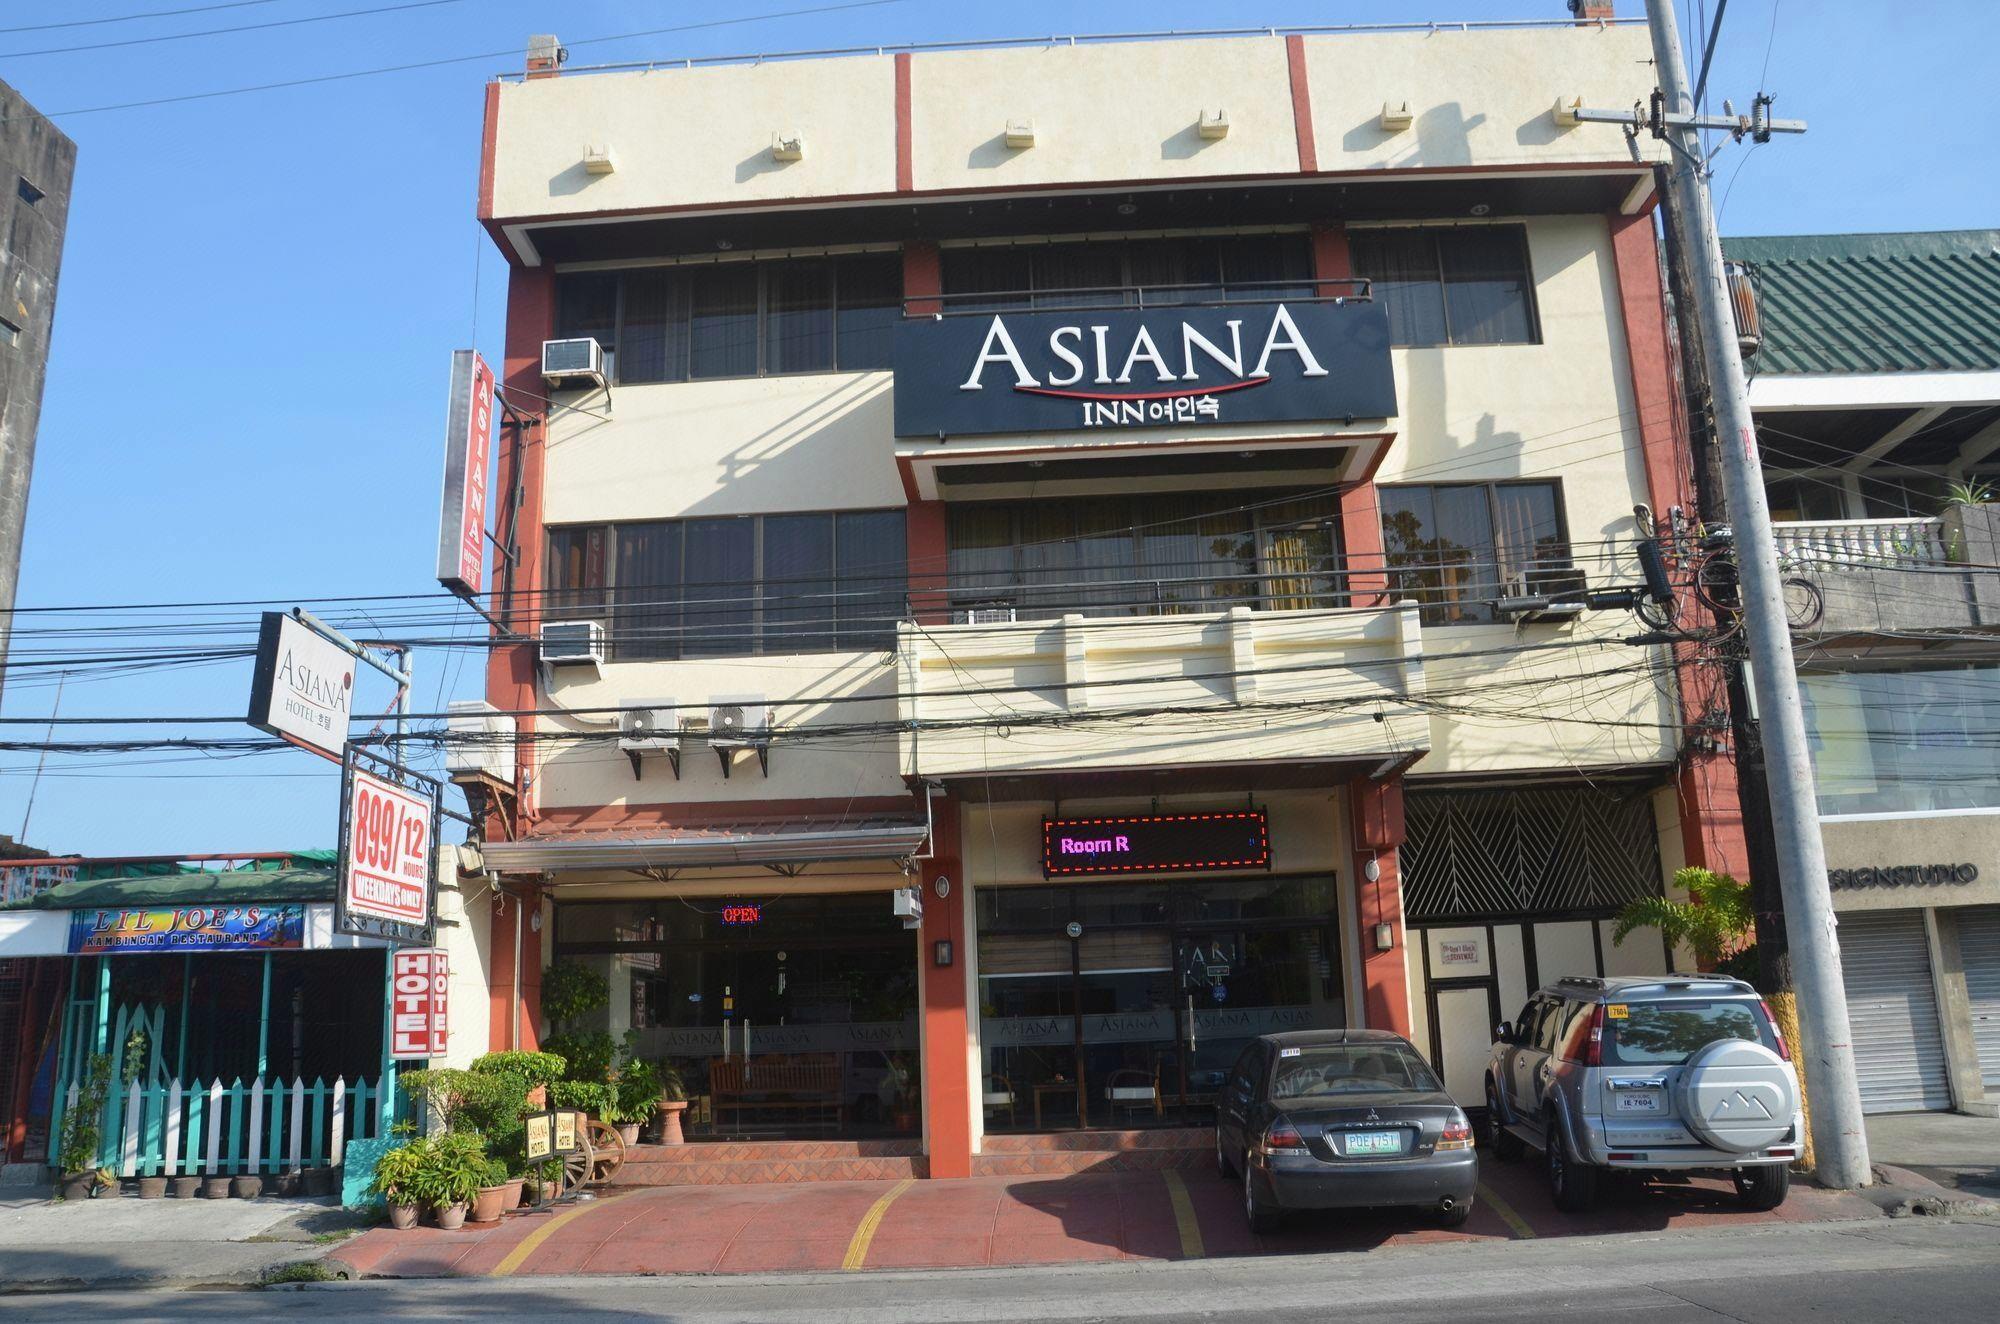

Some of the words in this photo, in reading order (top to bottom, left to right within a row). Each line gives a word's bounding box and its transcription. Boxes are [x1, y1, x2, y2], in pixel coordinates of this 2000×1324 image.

[960, 303, 1328, 390] ASIANA
[1083, 399, 1145, 425] INN
[1149, 394, 1219, 423] 여인숙
[469, 380, 489, 545] ASIANA
[279, 648, 346, 714] ASIANA
[286, 698, 314, 723] HOTEL
[1061, 837, 1112, 854] Room
[1115, 835, 1129, 852] R
[403, 860, 424, 879] HOURS
[1827, 862, 1979, 893] SIGNSTUDIO
[355, 873, 401, 907] WEEKDAYS
[401, 888, 422, 908] ONLY
[92, 909, 153, 932] LIL
[166, 907, 261, 934] JOE'S
[723, 907, 758, 922] OPEN
[87, 934, 165, 947] KAMBINGAN
[171, 932, 260, 945] RESTAURANT
[396, 955, 429, 1051] HOTEL
[433, 954, 447, 1051] HOTEL
[1376, 1133, 1395, 1146] 751
